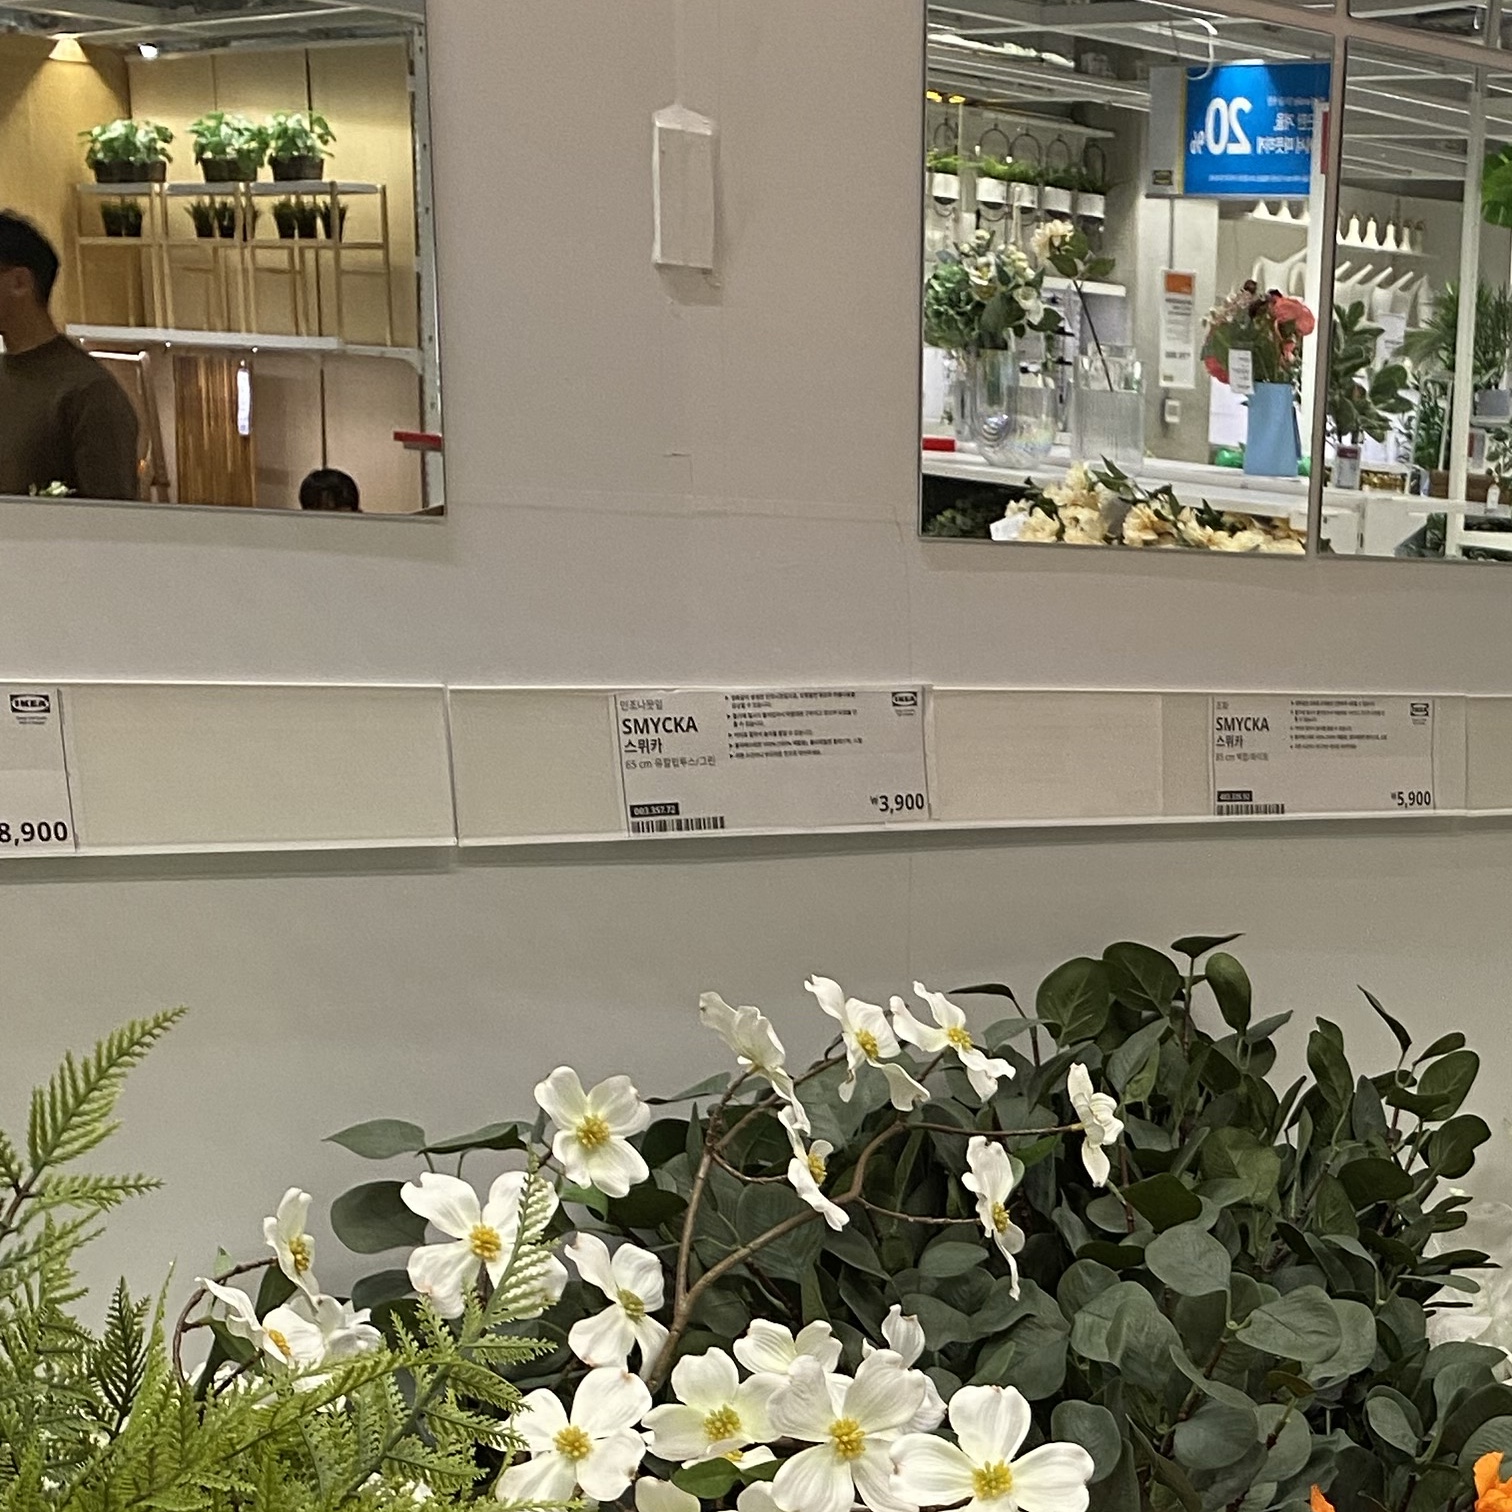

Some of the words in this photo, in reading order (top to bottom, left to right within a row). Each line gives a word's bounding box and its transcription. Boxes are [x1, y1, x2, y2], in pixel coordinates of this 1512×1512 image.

[622, 716, 698, 735] SMYCKA
[1216, 717, 1270, 732] SMYCKA
[624, 737, 663, 754] 스뮈카
[639, 760, 652, 768] cm
